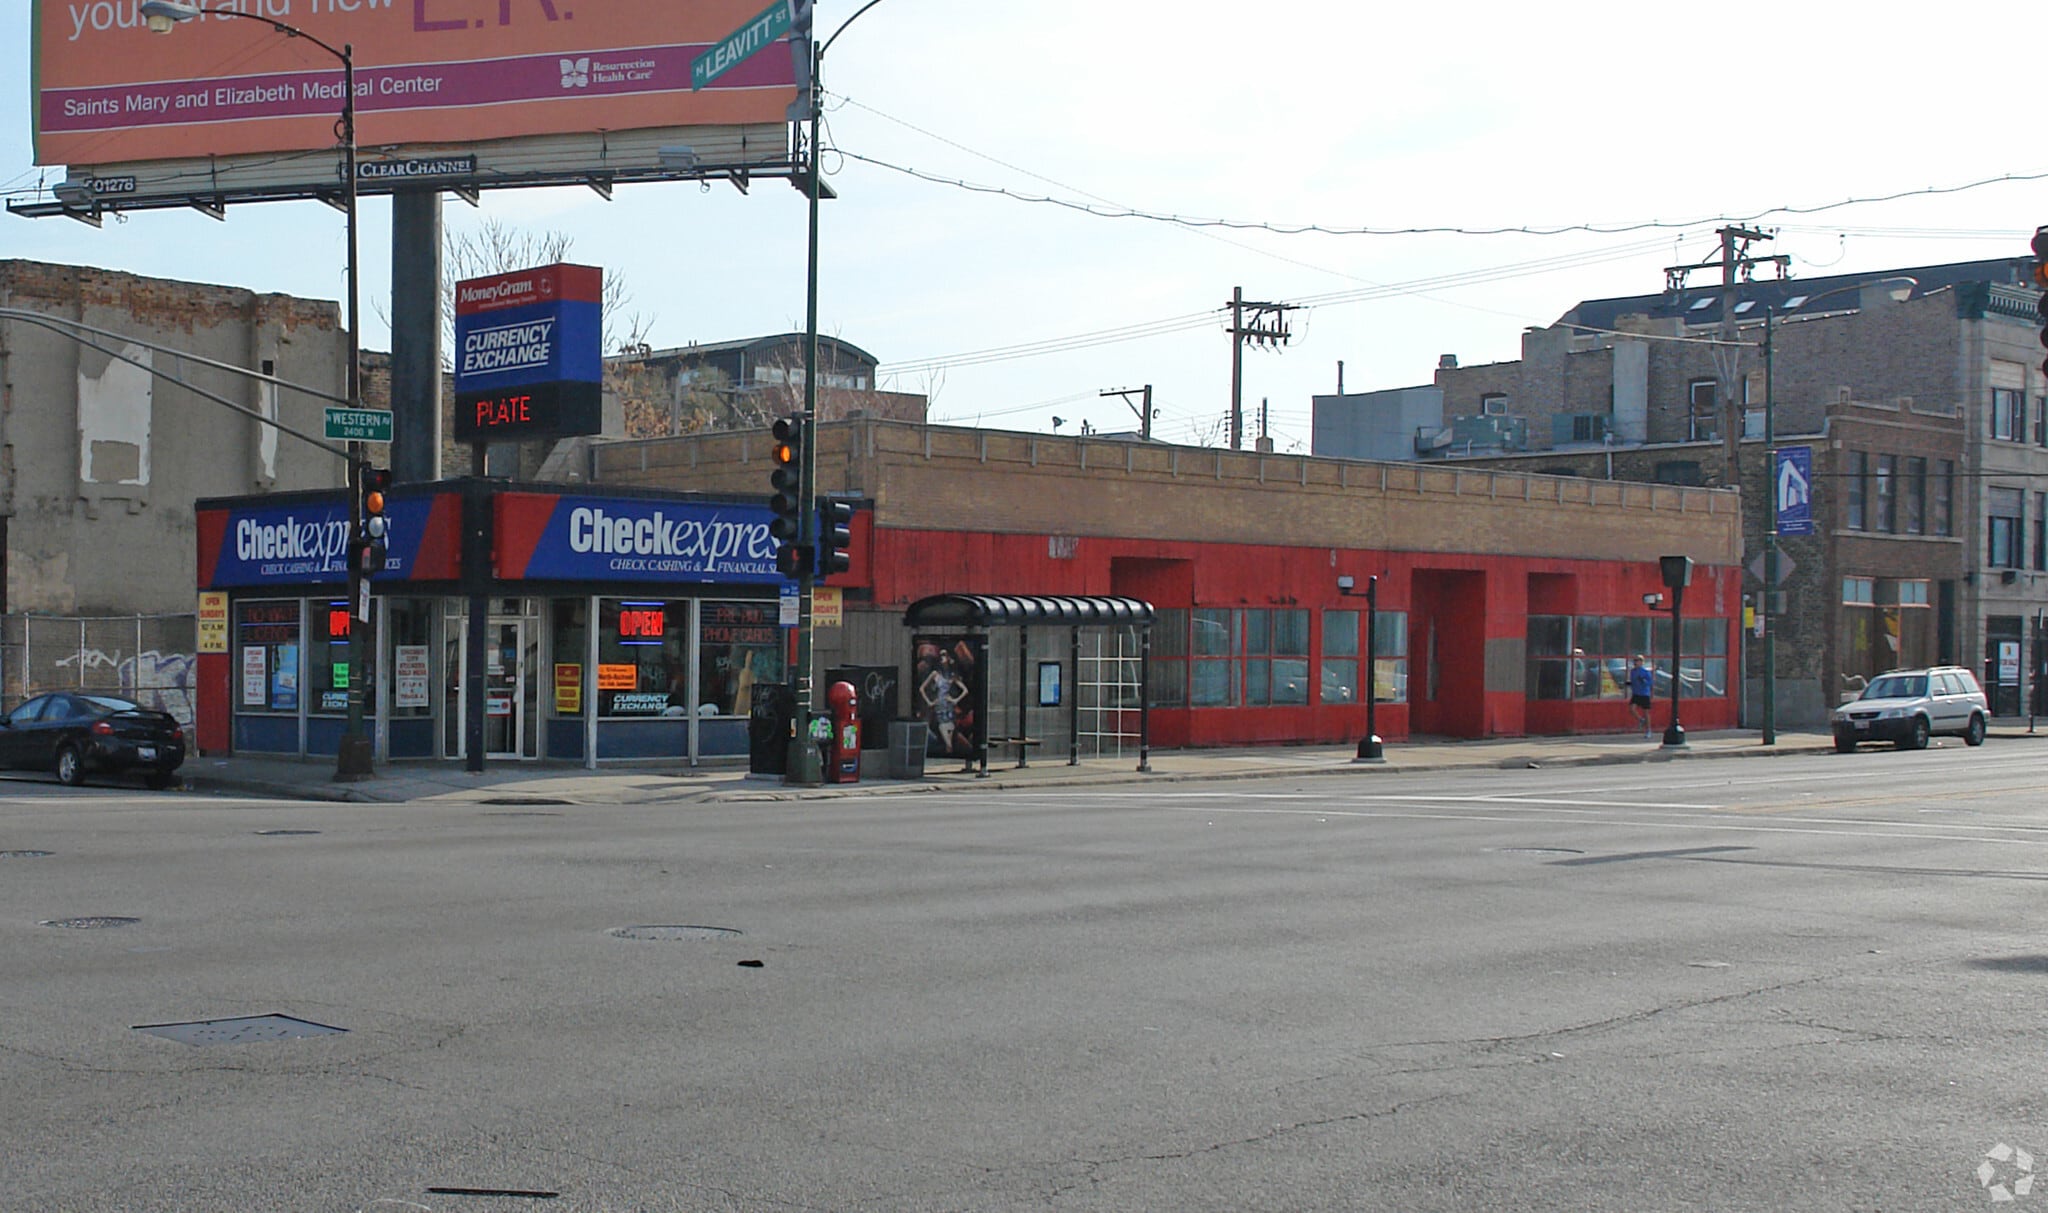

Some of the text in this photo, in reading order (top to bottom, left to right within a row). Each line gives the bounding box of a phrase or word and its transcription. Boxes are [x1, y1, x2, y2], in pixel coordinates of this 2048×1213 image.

[68, 1, 148, 41] you
[696, 8, 787, 79] N LEAVITT ST
[593, 59, 655, 72] Resurrection
[63, 98, 119, 117] Saints
[125, 94, 170, 113] Mary
[175, 89, 209, 109] and
[215, 83, 295, 107] Elizabeth
[379, 75, 442, 95] Center
[460, 280, 533, 304] MoneyGram
[465, 323, 552, 353] CURRENCY
[464, 342, 550, 371] EXCHANGE
[333, 413, 380, 426] WESTERN
[476, 396, 531, 427] PLATE
[610, 558, 647, 571] CHECK
[648, 559, 692, 572] CASHING
[717, 562, 765, 574] FINANCIAL
[620, 610, 664, 636] OPEN
[613, 694, 669, 703] CURRENCY
[613, 702, 668, 711] EXCHANGE
